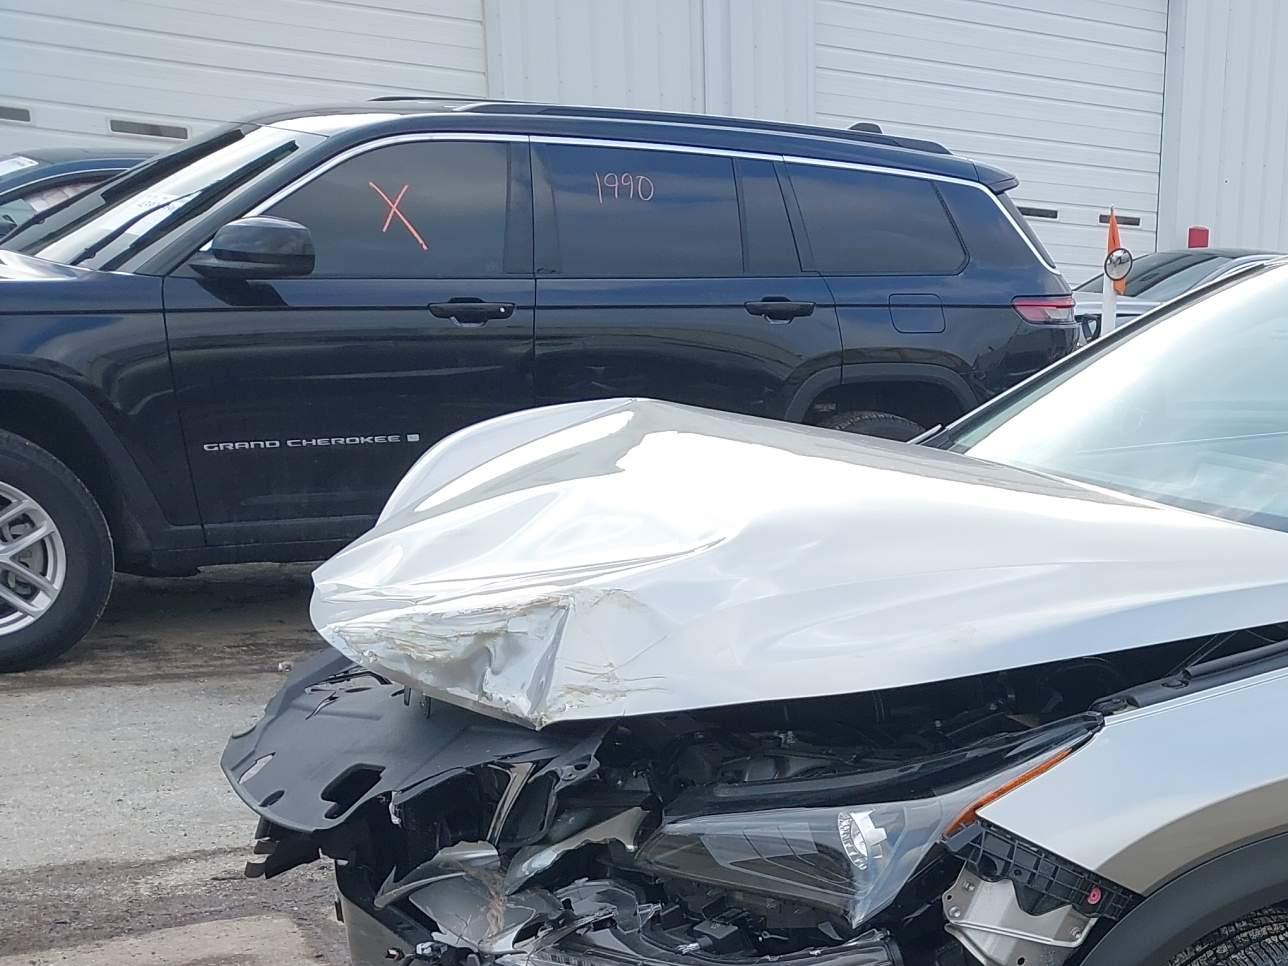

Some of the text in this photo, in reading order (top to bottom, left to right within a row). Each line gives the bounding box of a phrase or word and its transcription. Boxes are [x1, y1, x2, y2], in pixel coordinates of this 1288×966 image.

[595, 171, 655, 204] 1990
[203, 440, 280, 451] GRAND
[286, 435, 401, 447] CHEROKEE
